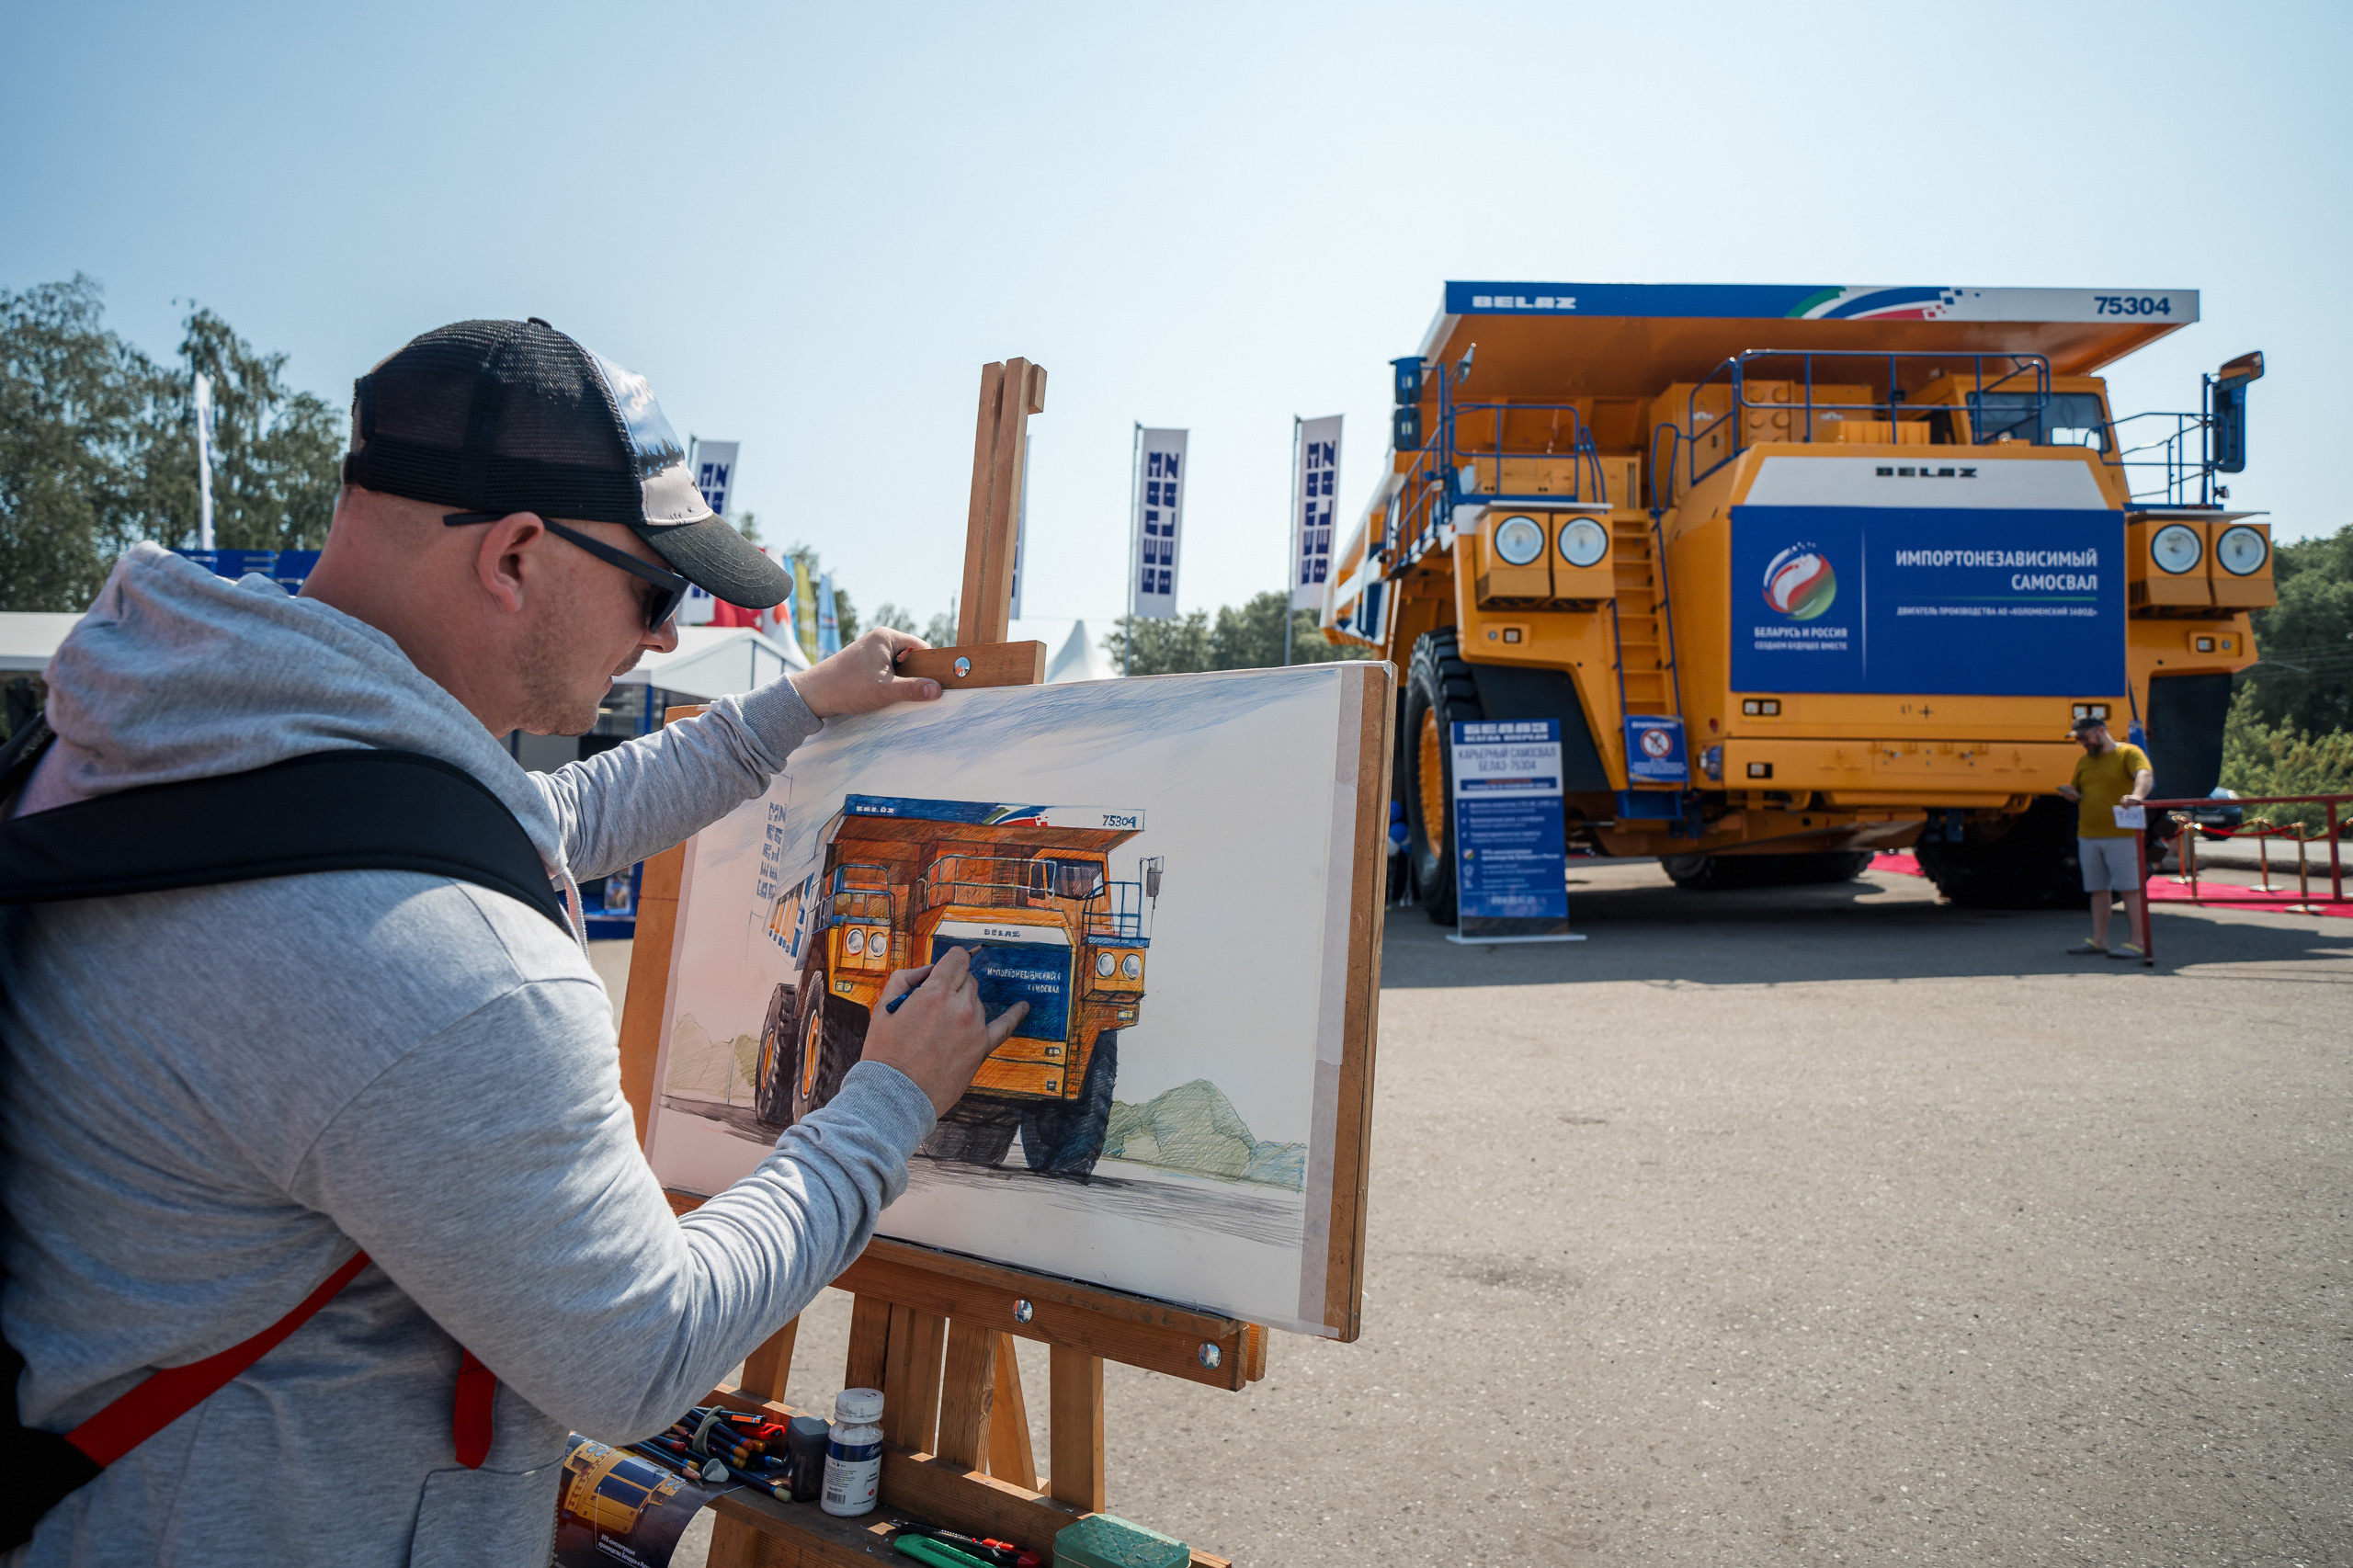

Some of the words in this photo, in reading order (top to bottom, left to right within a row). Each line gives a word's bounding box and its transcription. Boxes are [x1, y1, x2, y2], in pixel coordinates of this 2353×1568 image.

[1472, 296, 1576, 309] BELAZ
[2094, 296, 2171, 315] 75304
[1876, 467, 1977, 478] BELAZ
[1895, 548, 2097, 567] ИМПОРТОНЕЗАВИСИМЫЙ
[2011, 574, 2098, 591] САМОСВАЛ
[1896, 607, 1938, 617] ДВИГАТЕЛЬ
[1938, 607, 1996, 617] ПРОИЗВОДСТВА
[1754, 627, 1802, 638] БЕЛАРУСЬ
[1802, 628, 1810, 638] И
[1811, 628, 1847, 639] РОССИЯ
[1103, 814, 1137, 829] 75304
[984, 929, 1020, 937] BELAZ
